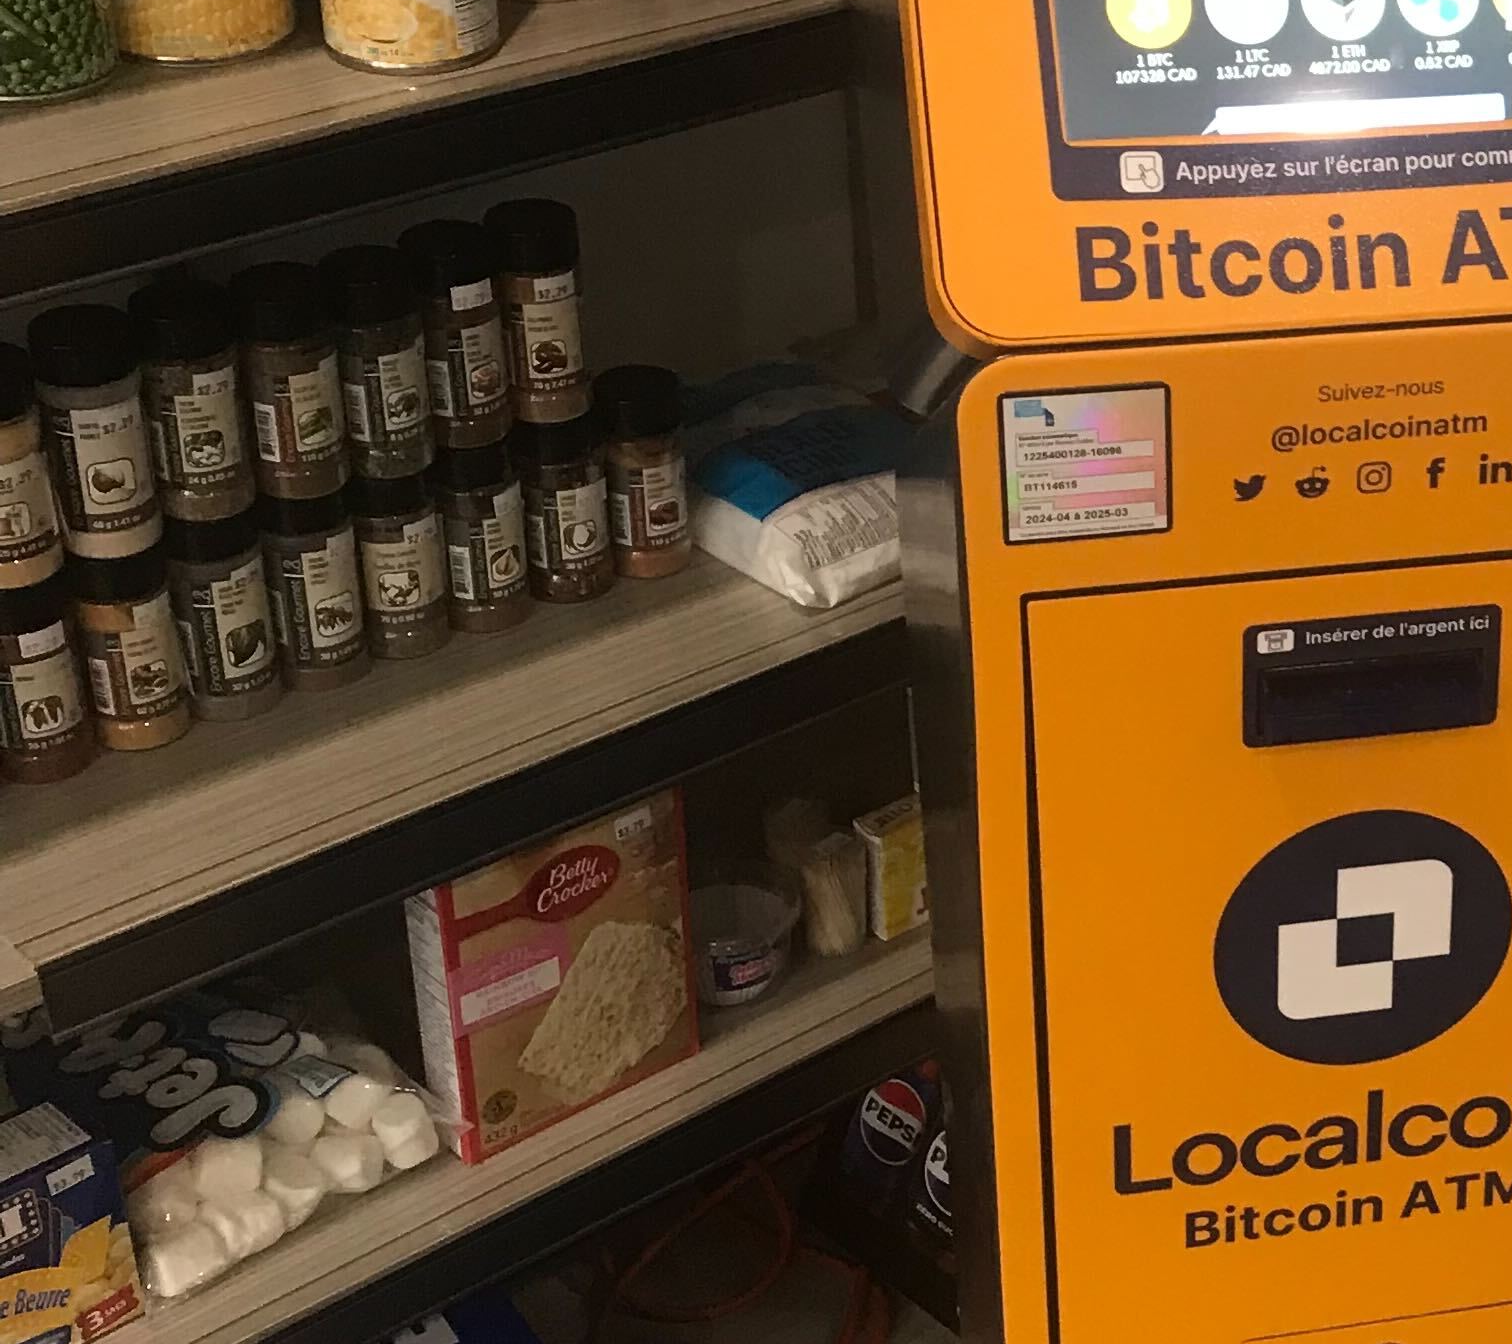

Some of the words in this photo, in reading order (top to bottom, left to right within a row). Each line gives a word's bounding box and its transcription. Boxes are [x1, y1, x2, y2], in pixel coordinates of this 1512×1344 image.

[1234, 49, 1244, 64] 1
[1245, 48, 1270, 63] LTC
[1331, 45, 1339, 59] 1
[1341, 44, 1366, 58] ETH
[1425, 40, 1434, 54] 1
[1136, 54, 1145, 68] 1
[1146, 52, 1174, 67] BTC
[1261, 62, 1292, 78] CAD
[1361, 57, 1392, 73] CAD
[1444, 54, 1474, 69] CAD
[1167, 67, 1198, 82] CAD
[1175, 158, 1277, 185] Appuyez
[1283, 157, 1320, 178] sur
[1324, 152, 1400, 176] l'écran
[1404, 150, 1457, 177] pour
[1074, 213, 1412, 303] Bitcoin
[1317, 379, 1446, 404] Suivez-nous
[1271, 413, 1489, 454] @localcoinatm
[1025, 511, 1071, 525] 2024-04
[1084, 507, 1129, 520] 2025-03
[1304, 627, 1370, 646] Insérer
[1372, 624, 1396, 640] de
[1399, 617, 1466, 638] l'argent
[1469, 614, 1491, 631] ici
[549, 855, 599, 890] Betty
[536, 870, 609, 914] Crocker
[1184, 1188, 1384, 1250] Bitcoin
[14, 1287, 72, 1316] Beurre
[86, 1310, 104, 1332] 3
